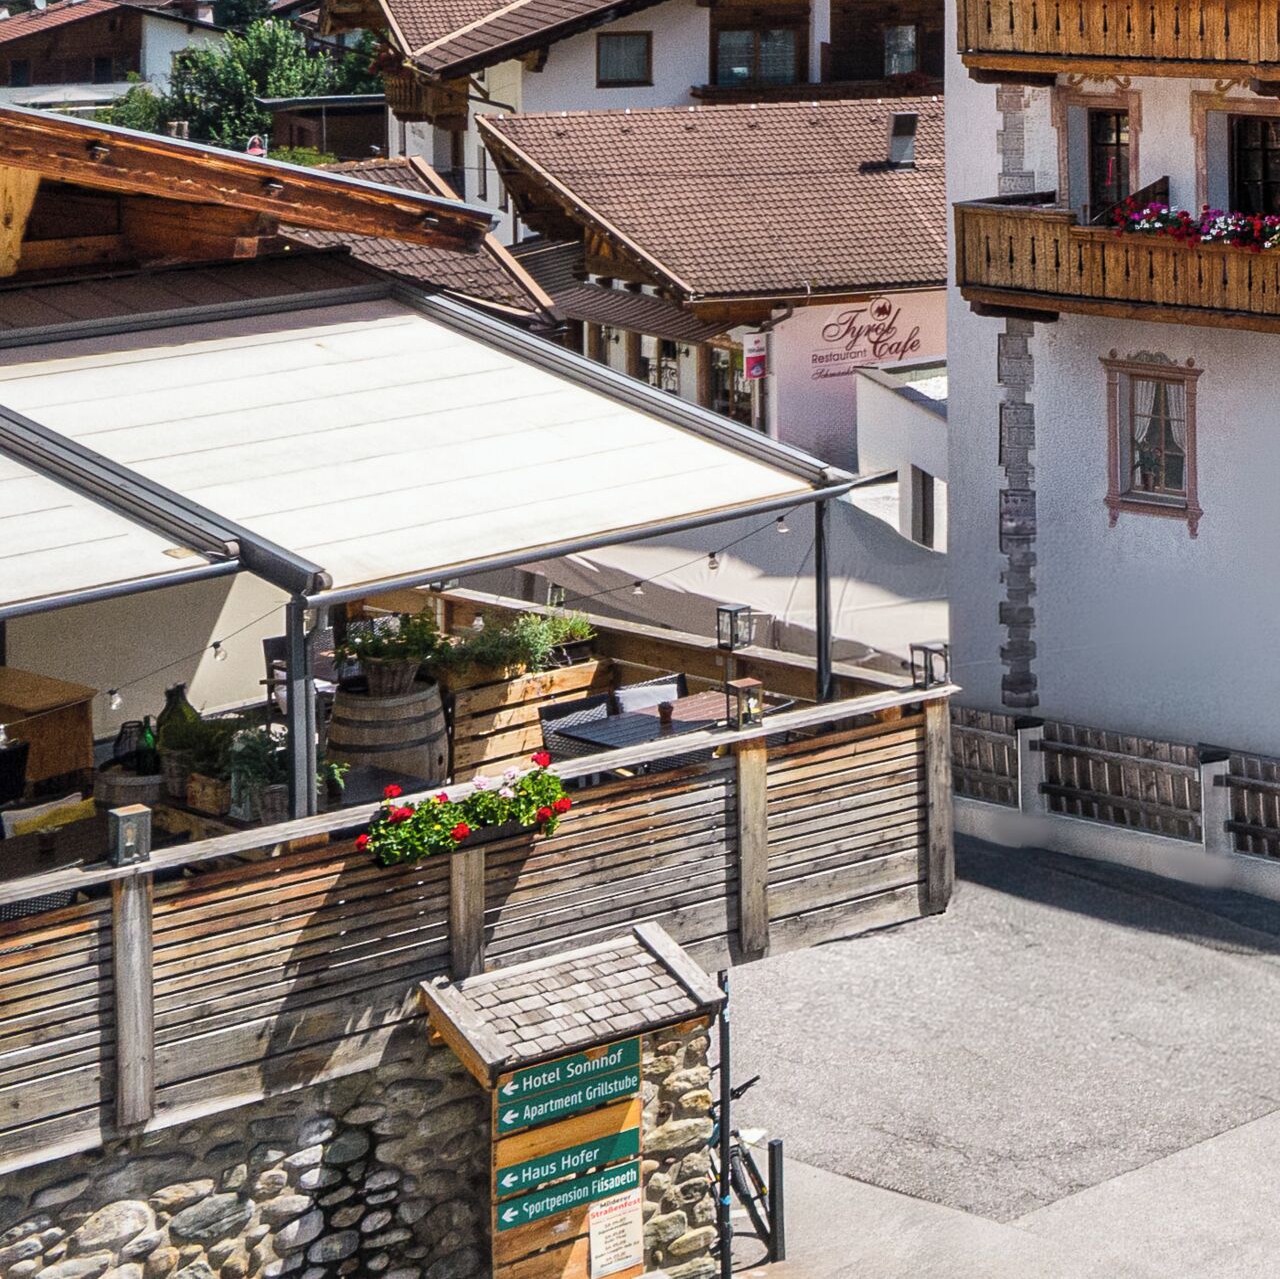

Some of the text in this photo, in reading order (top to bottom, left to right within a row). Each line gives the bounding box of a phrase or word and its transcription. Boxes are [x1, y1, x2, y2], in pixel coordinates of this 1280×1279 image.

[822, 308, 902, 351] Tyrol
[867, 326, 921, 361] Cafe
[811, 348, 867, 364] Restaurant
[523, 1067, 561, 1091] Hotel
[523, 1075, 638, 1120] Apartment Grillstube
[521, 1148, 600, 1183] Haus Hofer
[522, 1186, 589, 1219] Sportpension
[590, 1198, 641, 1218] Straßenfest
